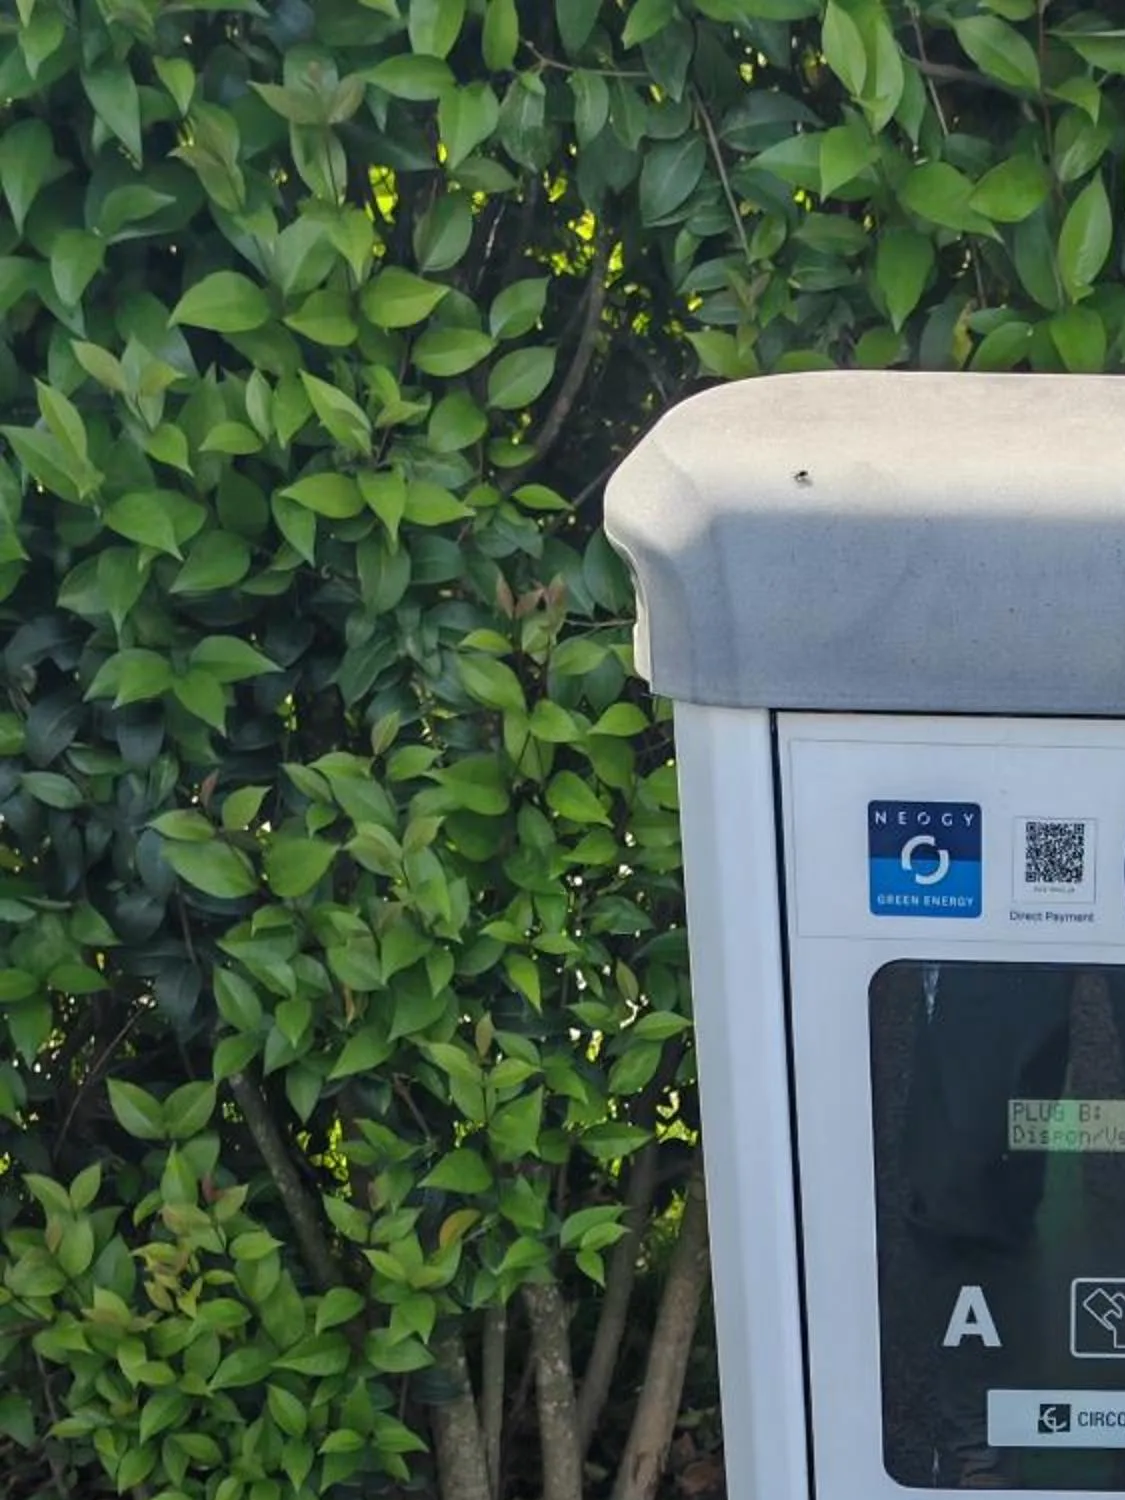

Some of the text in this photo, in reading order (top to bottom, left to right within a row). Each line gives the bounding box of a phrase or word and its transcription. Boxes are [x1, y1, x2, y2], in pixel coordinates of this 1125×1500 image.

[875, 811, 974, 827] NEOGY
[877, 894, 974, 907] GREEN ENERGY
[1009, 911, 1095, 922] Direct Payment
[1012, 1102, 1101, 1122] PLUG B:
[942, 1285, 1002, 1347] A
